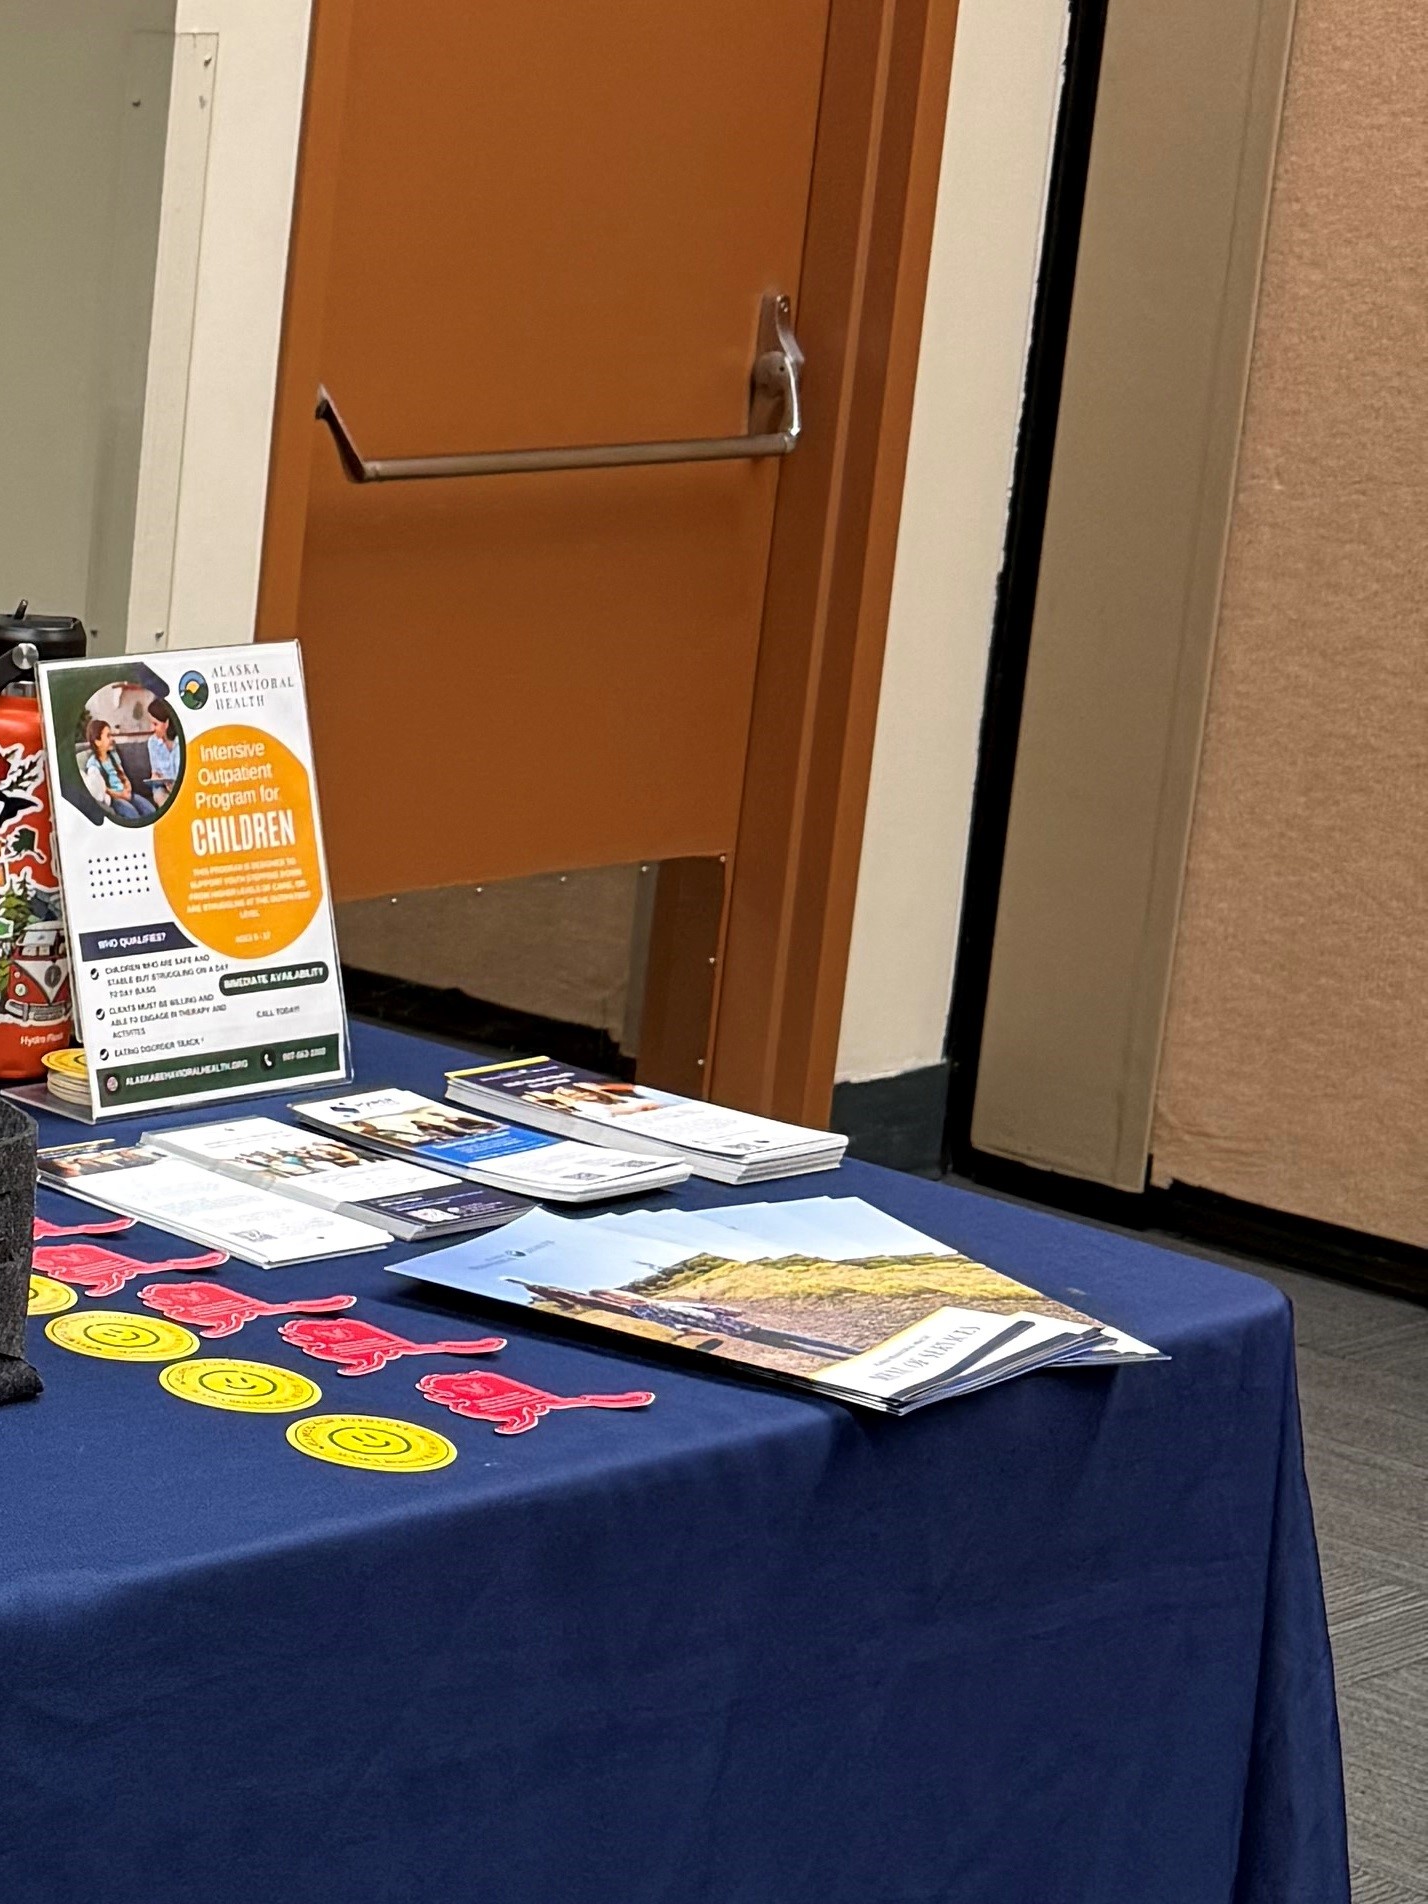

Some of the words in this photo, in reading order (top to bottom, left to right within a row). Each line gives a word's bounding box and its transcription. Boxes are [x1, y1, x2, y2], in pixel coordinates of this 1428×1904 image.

[212, 663, 260, 678] ALASKA
[214, 676, 294, 694] BEHAVIORAL
[216, 695, 265, 710] HEALTH
[200, 742, 265, 762] Intensive
[198, 763, 272, 787] Outpatient
[195, 791, 256, 812] Program
[260, 786, 280, 802] for
[191, 809, 296, 856] CHILDREN
